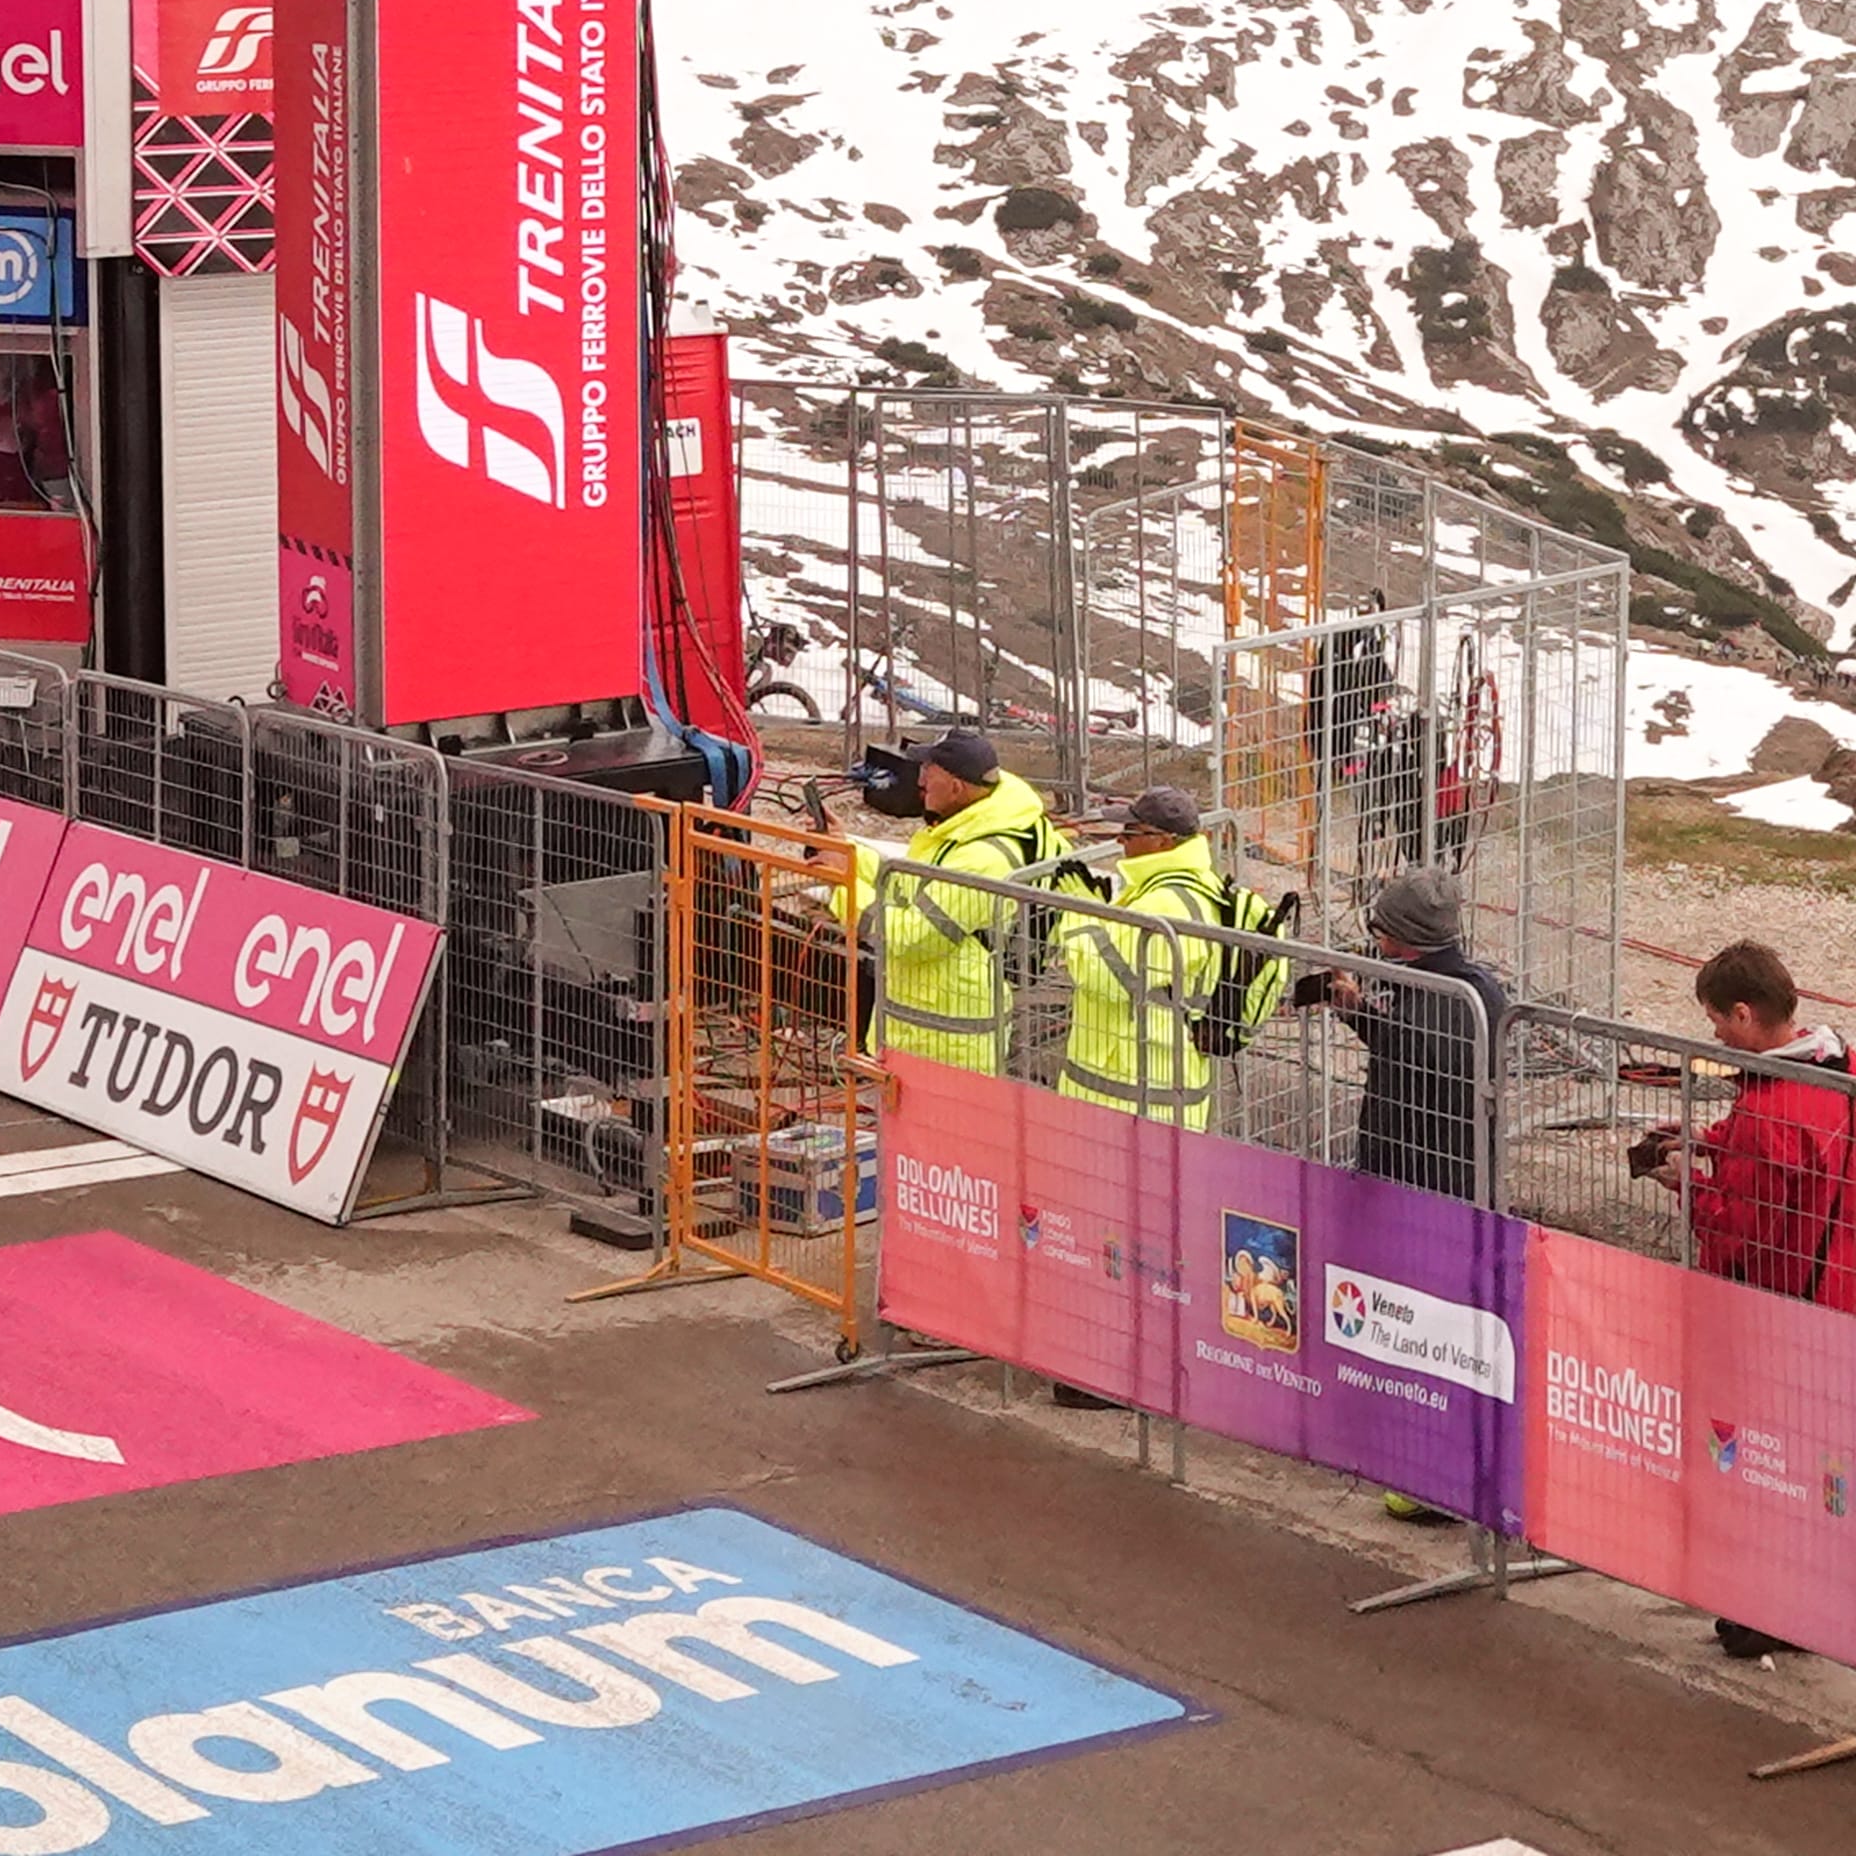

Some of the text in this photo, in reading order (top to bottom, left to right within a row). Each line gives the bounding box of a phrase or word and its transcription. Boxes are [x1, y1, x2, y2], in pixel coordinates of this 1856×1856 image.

[580, 20, 606, 116] STATO
[310, 42, 331, 346] TRENITALIA
[580, 124, 607, 217] DELLO
[581, 228, 607, 371] FERROVIE
[581, 379, 608, 509] GRUPPO
[59, 862, 405, 1046] enel enel
[68, 1001, 284, 1156] TUDOR
[896, 1181, 999, 1240] BELLUNESI
[1371, 1290, 1415, 1326] Veneto
[1546, 1384, 1681, 1460] BELLUNESI
[383, 1556, 742, 1645] BANCA
